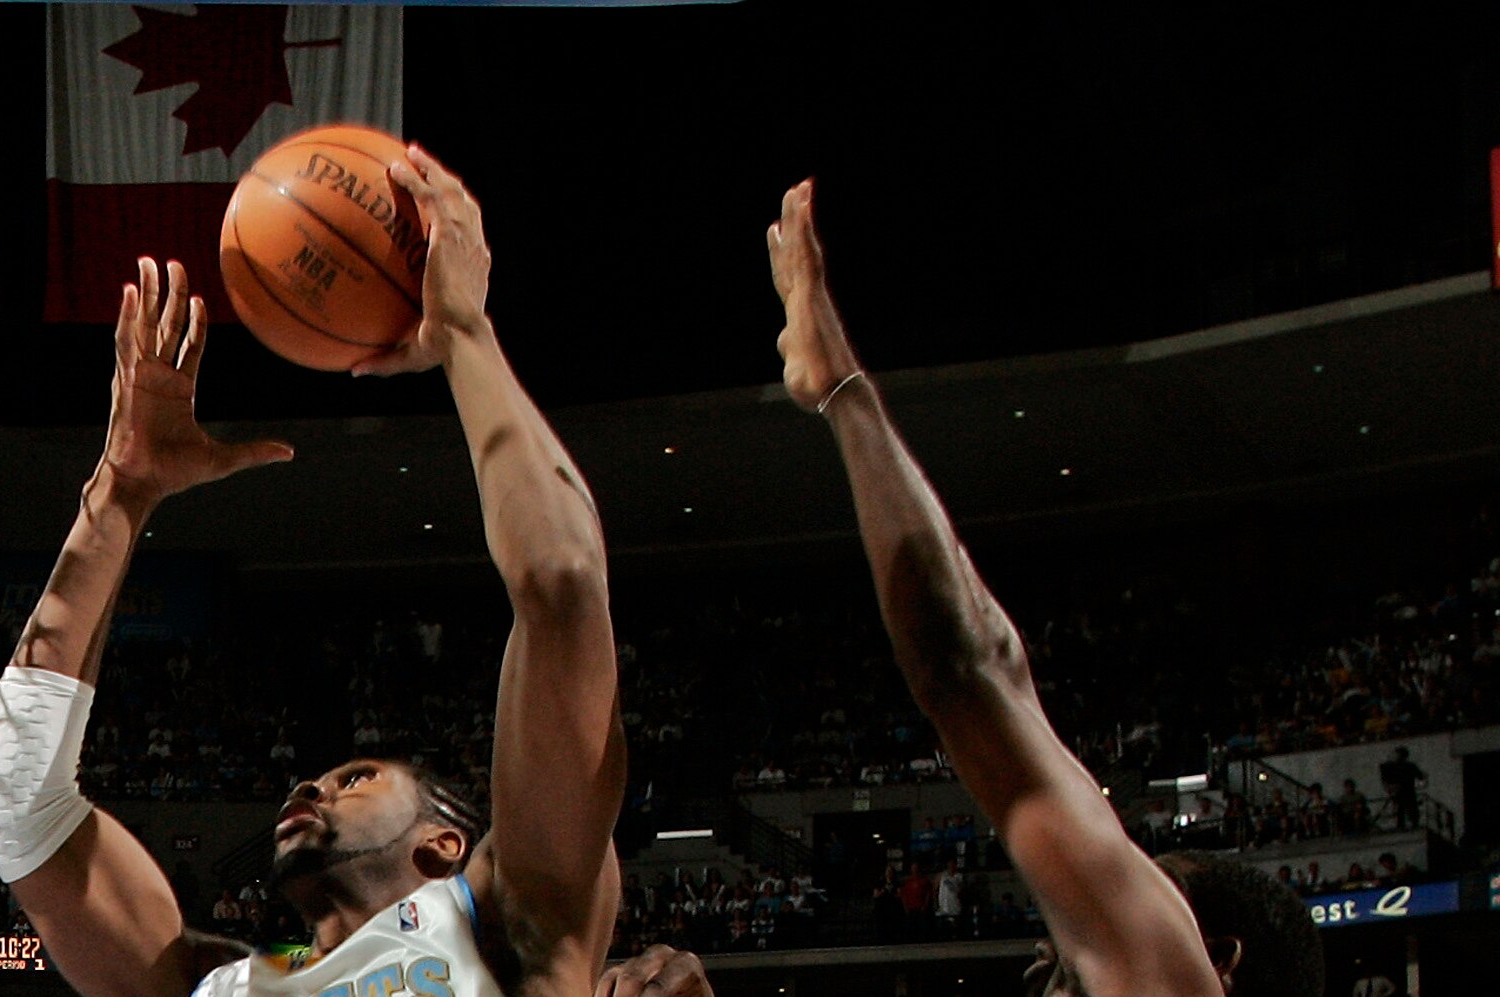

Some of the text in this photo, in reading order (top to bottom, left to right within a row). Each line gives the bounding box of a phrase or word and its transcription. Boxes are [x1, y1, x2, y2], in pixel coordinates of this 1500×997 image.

[293, 246, 338, 290] NBA
[0, 937, 41, 959] 10:27
[34, 959, 46, 970] 1
